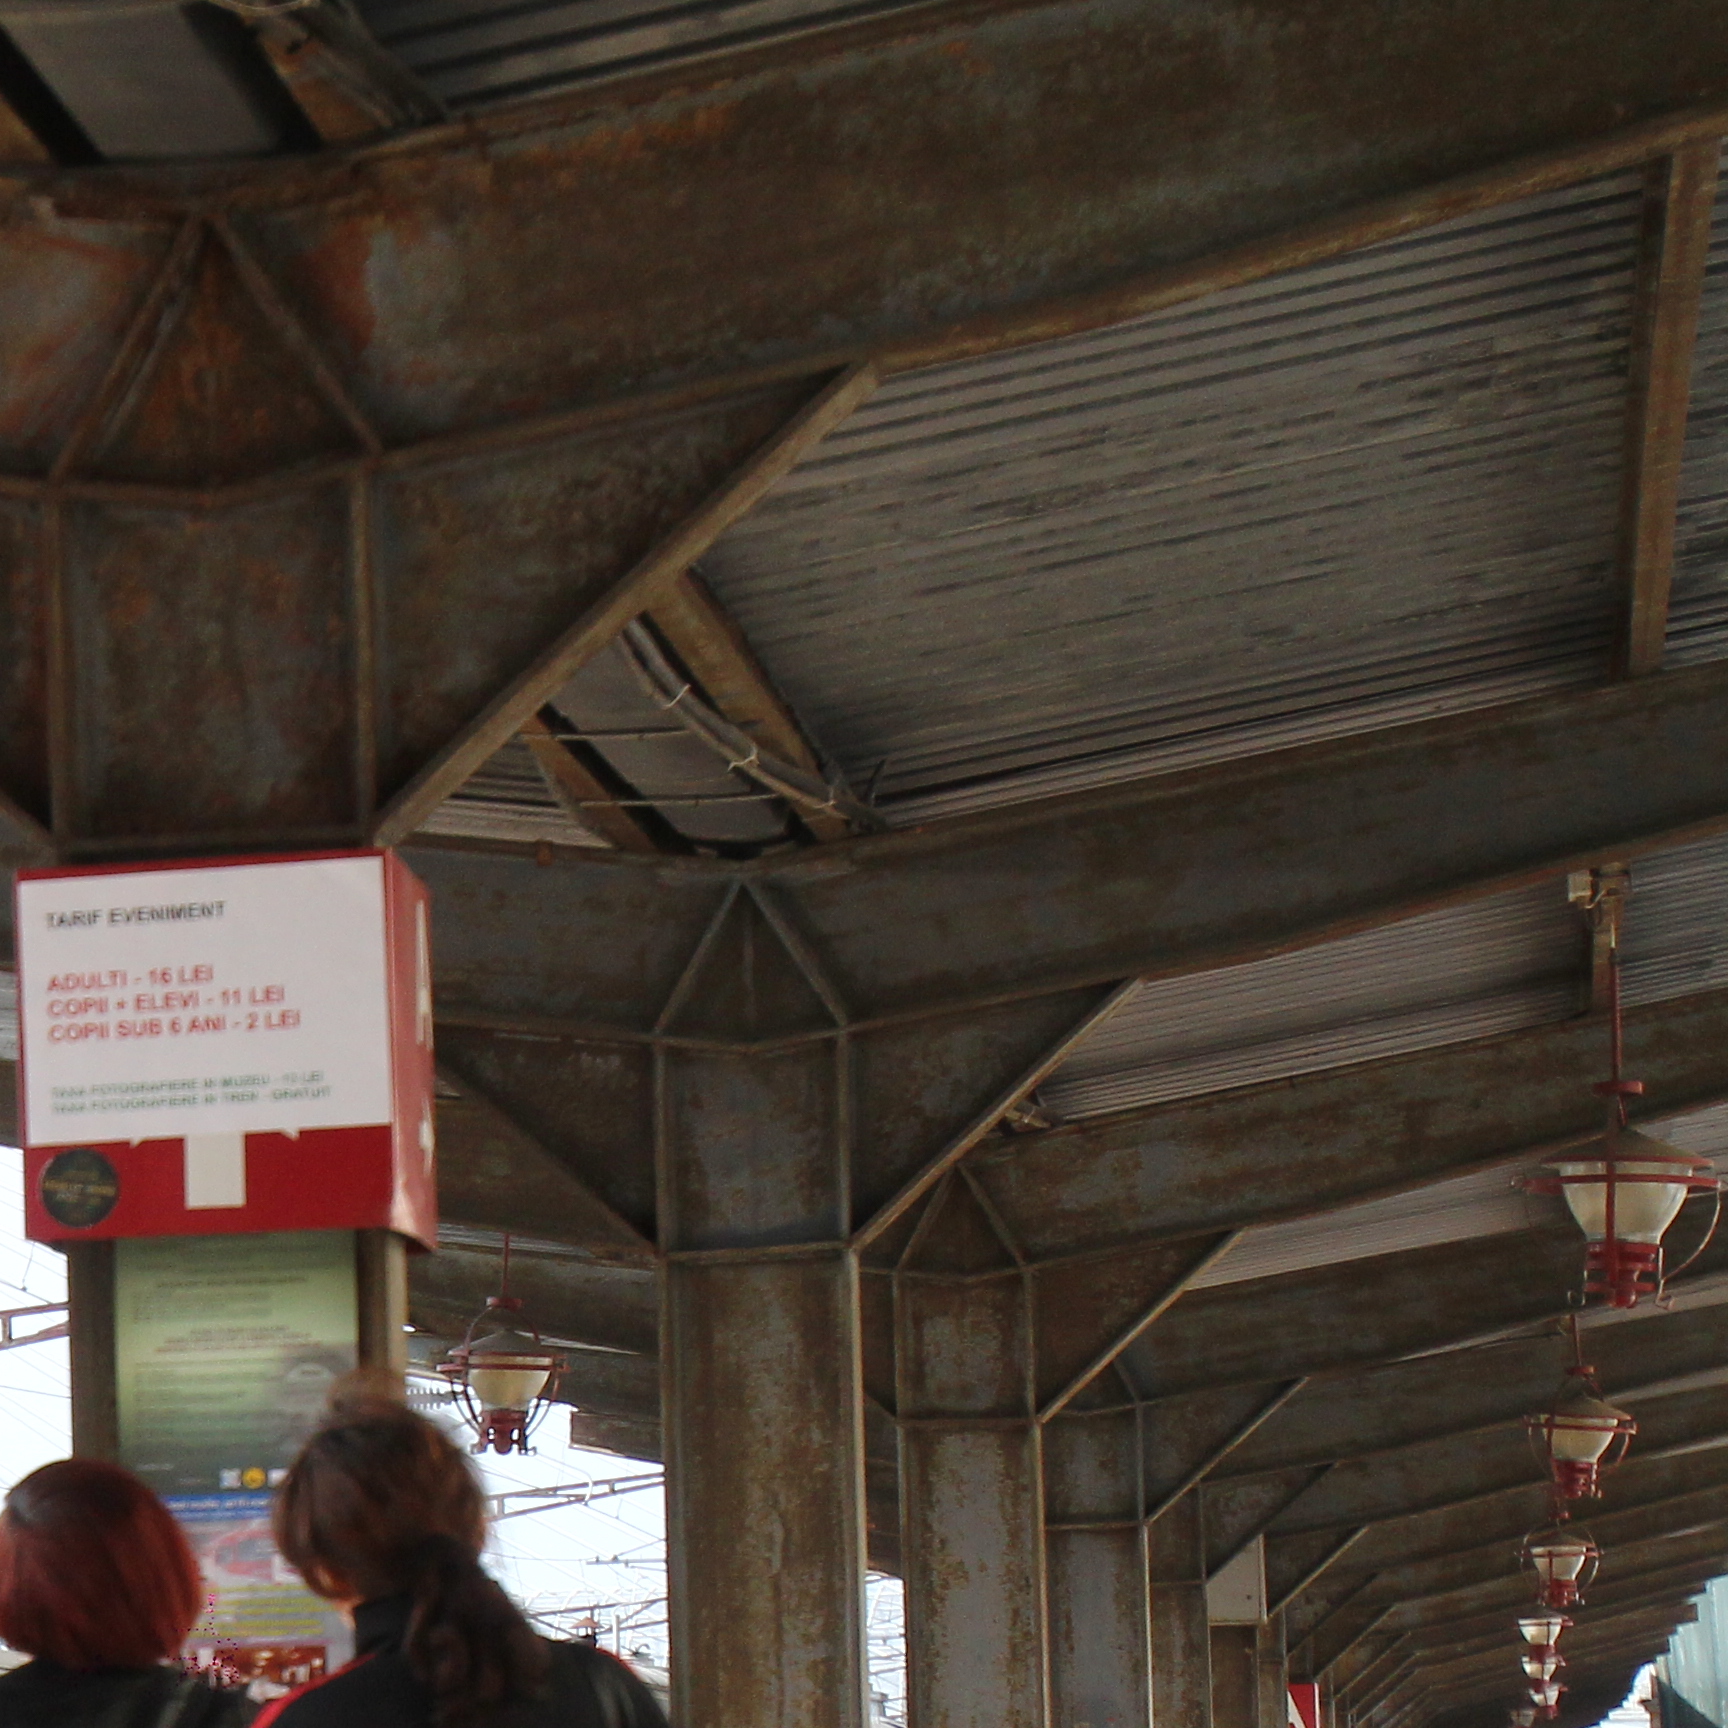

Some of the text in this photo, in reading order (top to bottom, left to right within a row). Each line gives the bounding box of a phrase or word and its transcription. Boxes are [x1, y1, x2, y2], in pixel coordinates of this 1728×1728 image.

[46, 901, 225, 928] TARIF EVENIMENT
[47, 970, 127, 992] ADULTI
[149, 967, 172, 985] 16
[178, 964, 213, 984] LEI
[47, 997, 108, 1016] COPII
[135, 990, 199, 1012] ELEVI
[222, 988, 241, 1006] 11
[250, 985, 285, 1004] LEI
[47, 1022, 109, 1042] COPII
[117, 1018, 162, 1038] SUB
[170, 1017, 181, 1034] 6
[188, 1014, 226, 1034] ANI
[247, 1013, 258, 1031] 2
[264, 1009, 301, 1029] LEI
